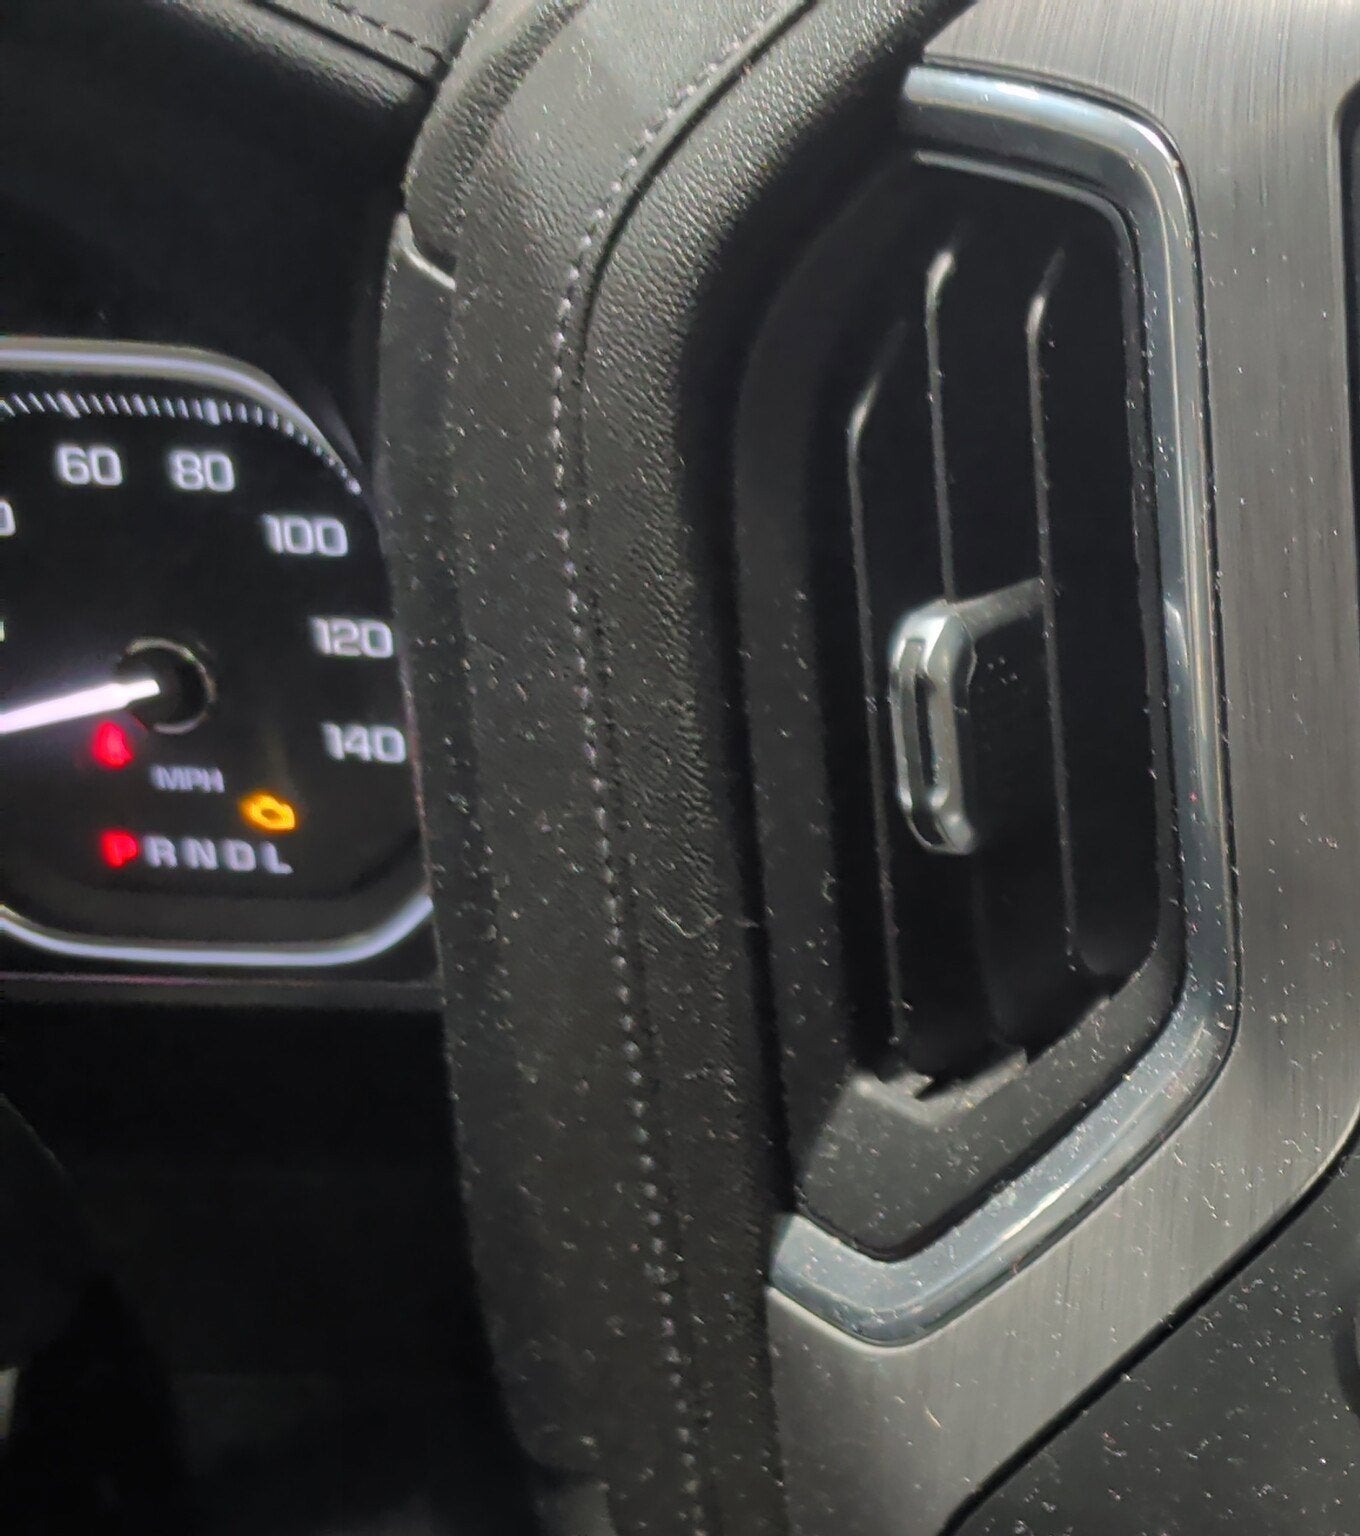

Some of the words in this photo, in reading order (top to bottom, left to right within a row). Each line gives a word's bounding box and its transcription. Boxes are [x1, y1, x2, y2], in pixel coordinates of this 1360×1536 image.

[56, 443, 123, 486] 60
[169, 449, 236, 492] 80
[263, 514, 349, 557] 100
[312, 617, 394, 659] 120
[323, 723, 407, 764] 140
[151, 765, 225, 793] MPH
